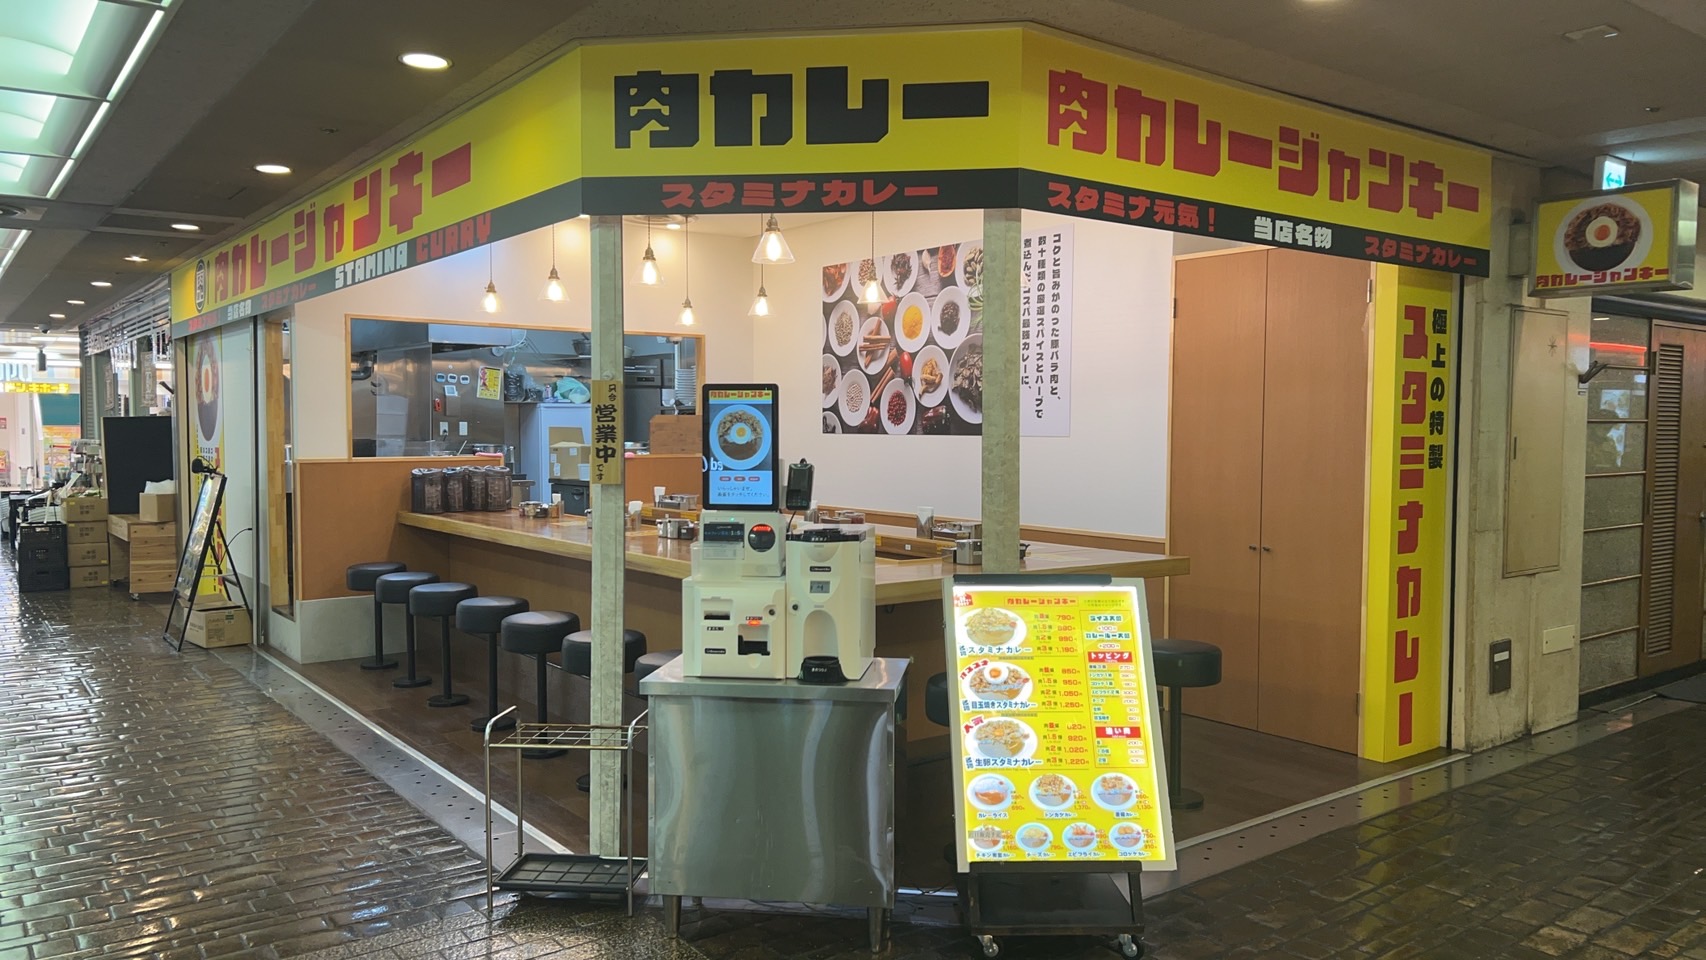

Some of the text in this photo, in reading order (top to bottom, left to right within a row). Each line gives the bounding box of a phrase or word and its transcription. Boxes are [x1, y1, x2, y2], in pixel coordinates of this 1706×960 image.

[614, 65, 989, 149] 肉カレー
[1047, 69, 1479, 219] 肉カレージャンキー
[661, 179, 938, 209] スタミナカレー
[214, 142, 471, 304] 肉カレージャンキー
[1254, 215, 1333, 249] 当店名物
[1364, 235, 1477, 268] スタミナカレー
[335, 211, 492, 289] STAMINA CURRY
[1536, 267, 1670, 287] 肉カレージャンキー
[1428, 308, 1447, 470] 極上の特製
[1393, 304, 1428, 747] スタミナカレー
[969, 646, 1031, 655] スタミナカレー
[1091, 652, 1129, 660] トッピング
[972, 700, 1036, 710] 目玉焼きスタミナカレー
[975, 757, 1042, 767] 生卵スタミナカレー
